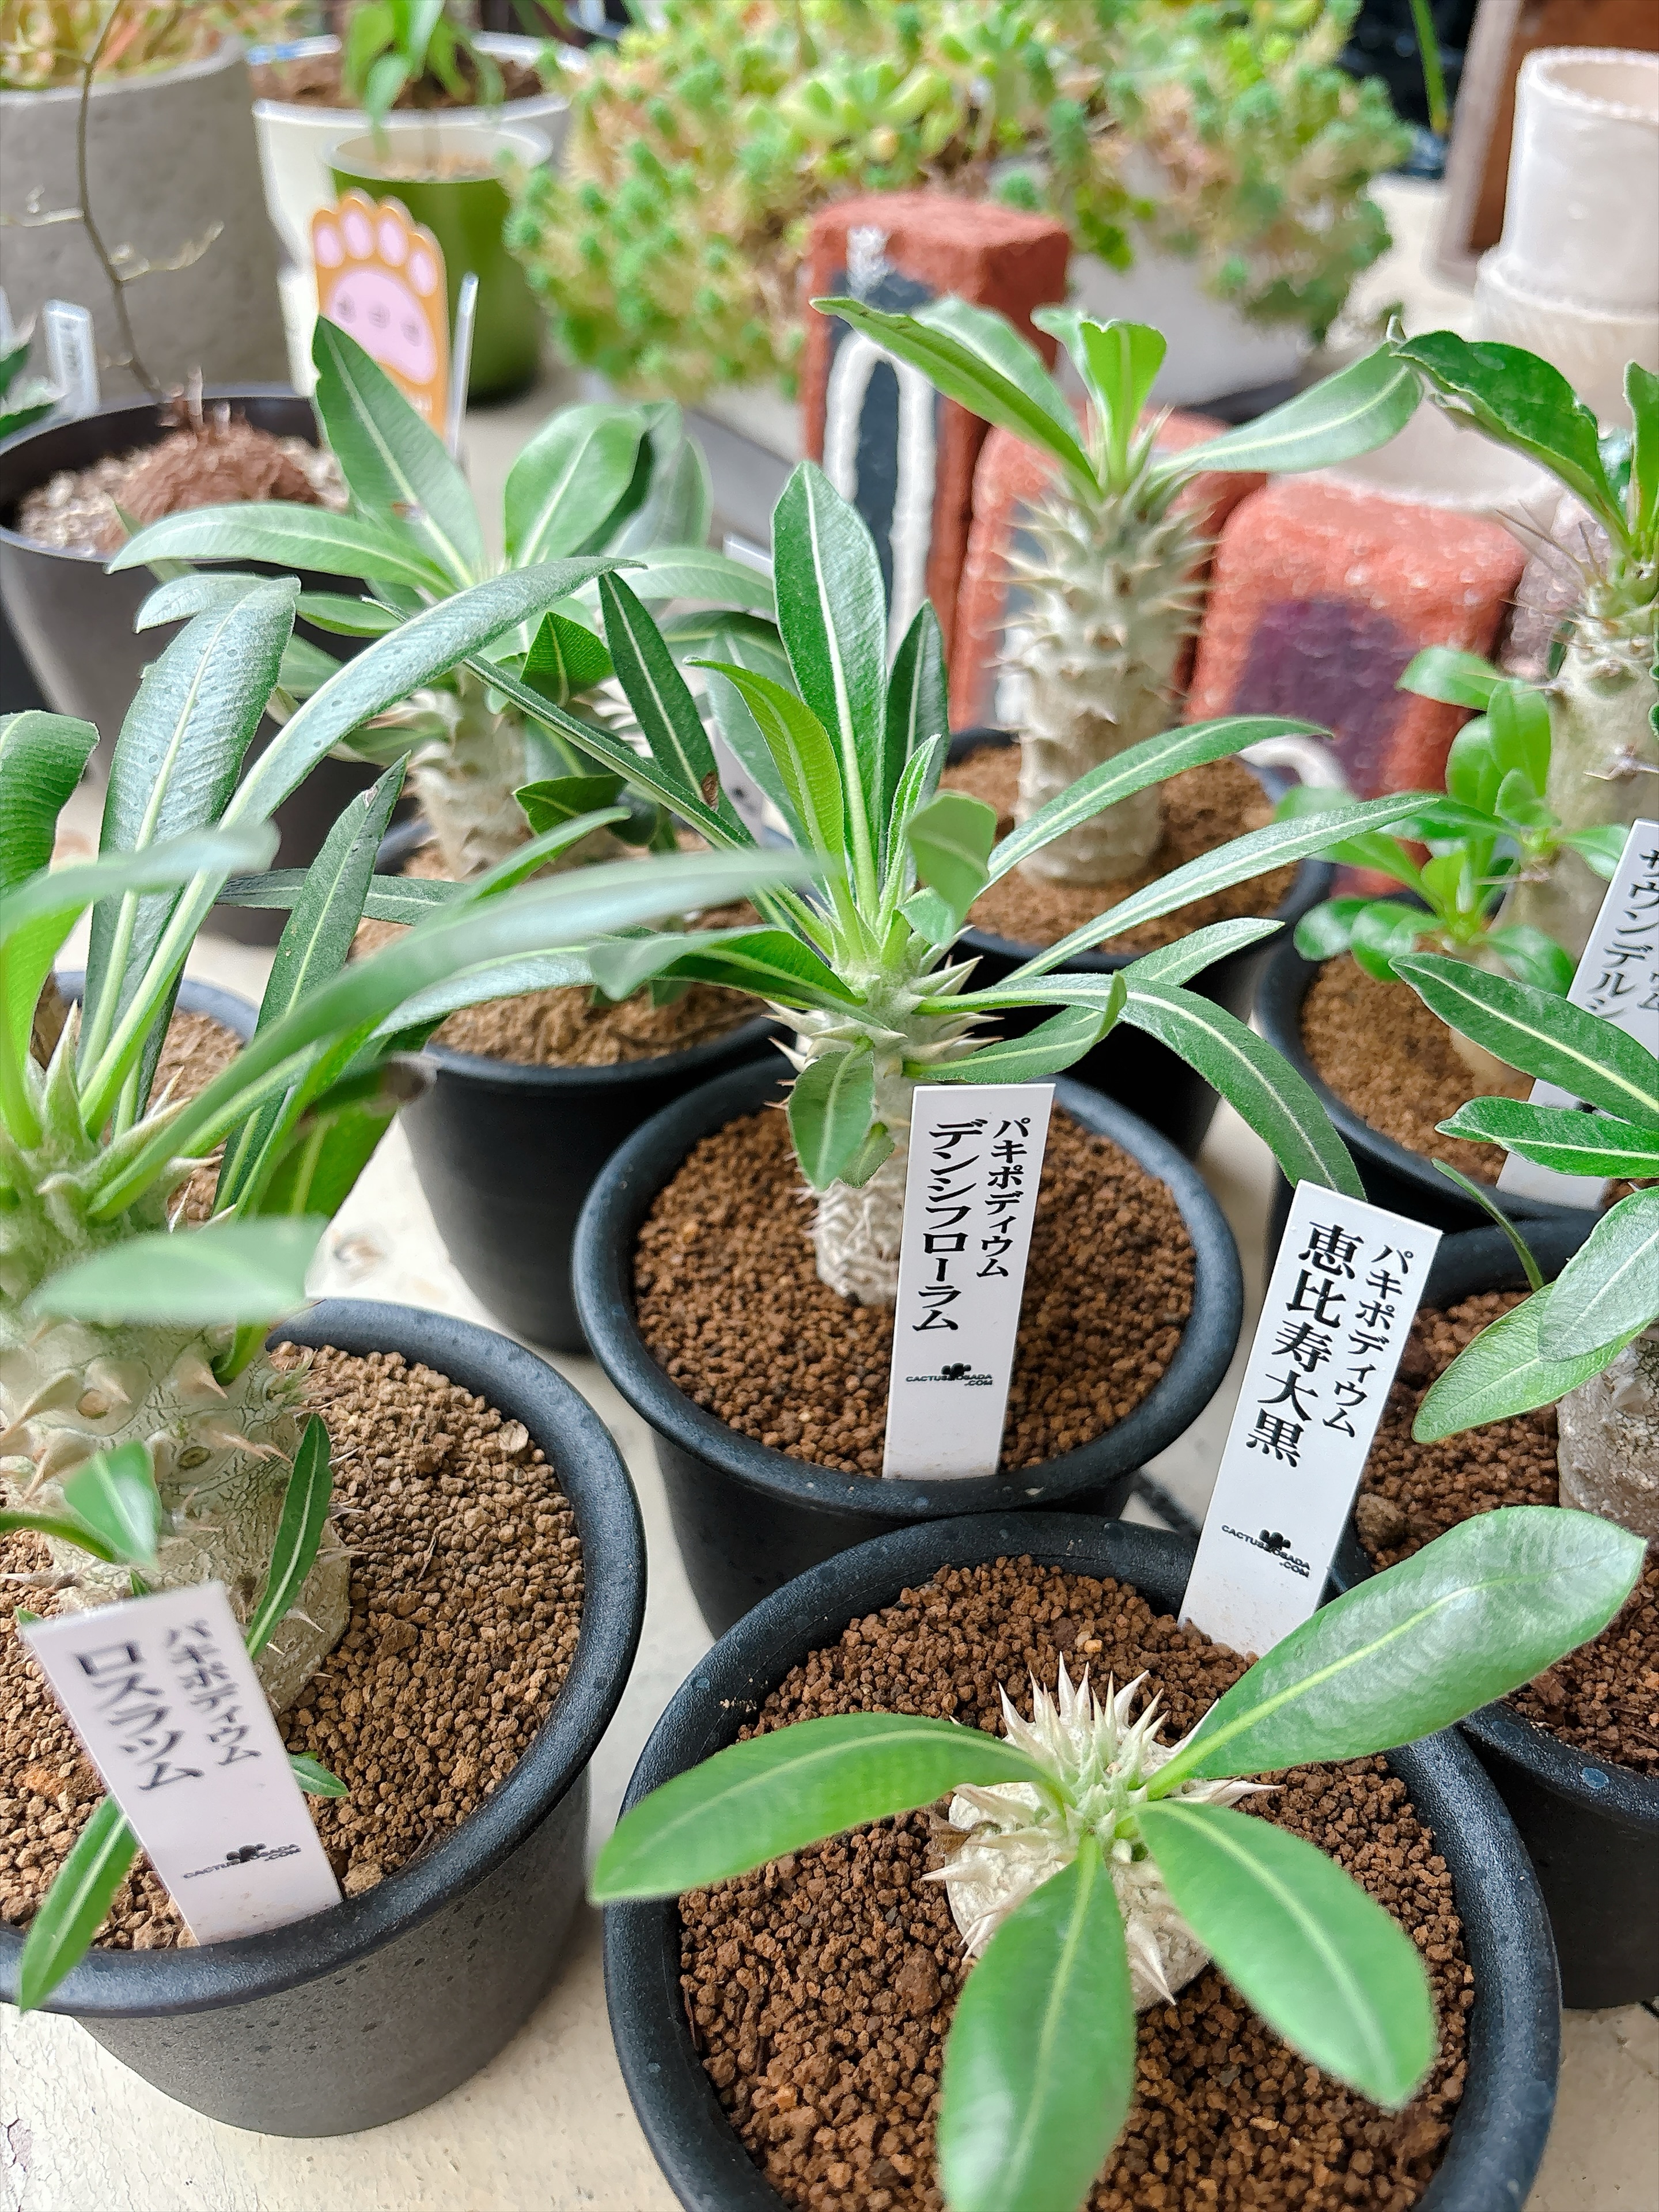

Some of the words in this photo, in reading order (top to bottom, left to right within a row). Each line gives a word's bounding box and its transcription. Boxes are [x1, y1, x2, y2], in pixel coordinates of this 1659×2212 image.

[912, 1118, 988, 1332] デンシフローラム
[975, 1117, 1031, 1278] パキポディウム
[1245, 1221, 1365, 1468] 恵比寿大黒
[1322, 1244, 1415, 1438] パキポディウム
